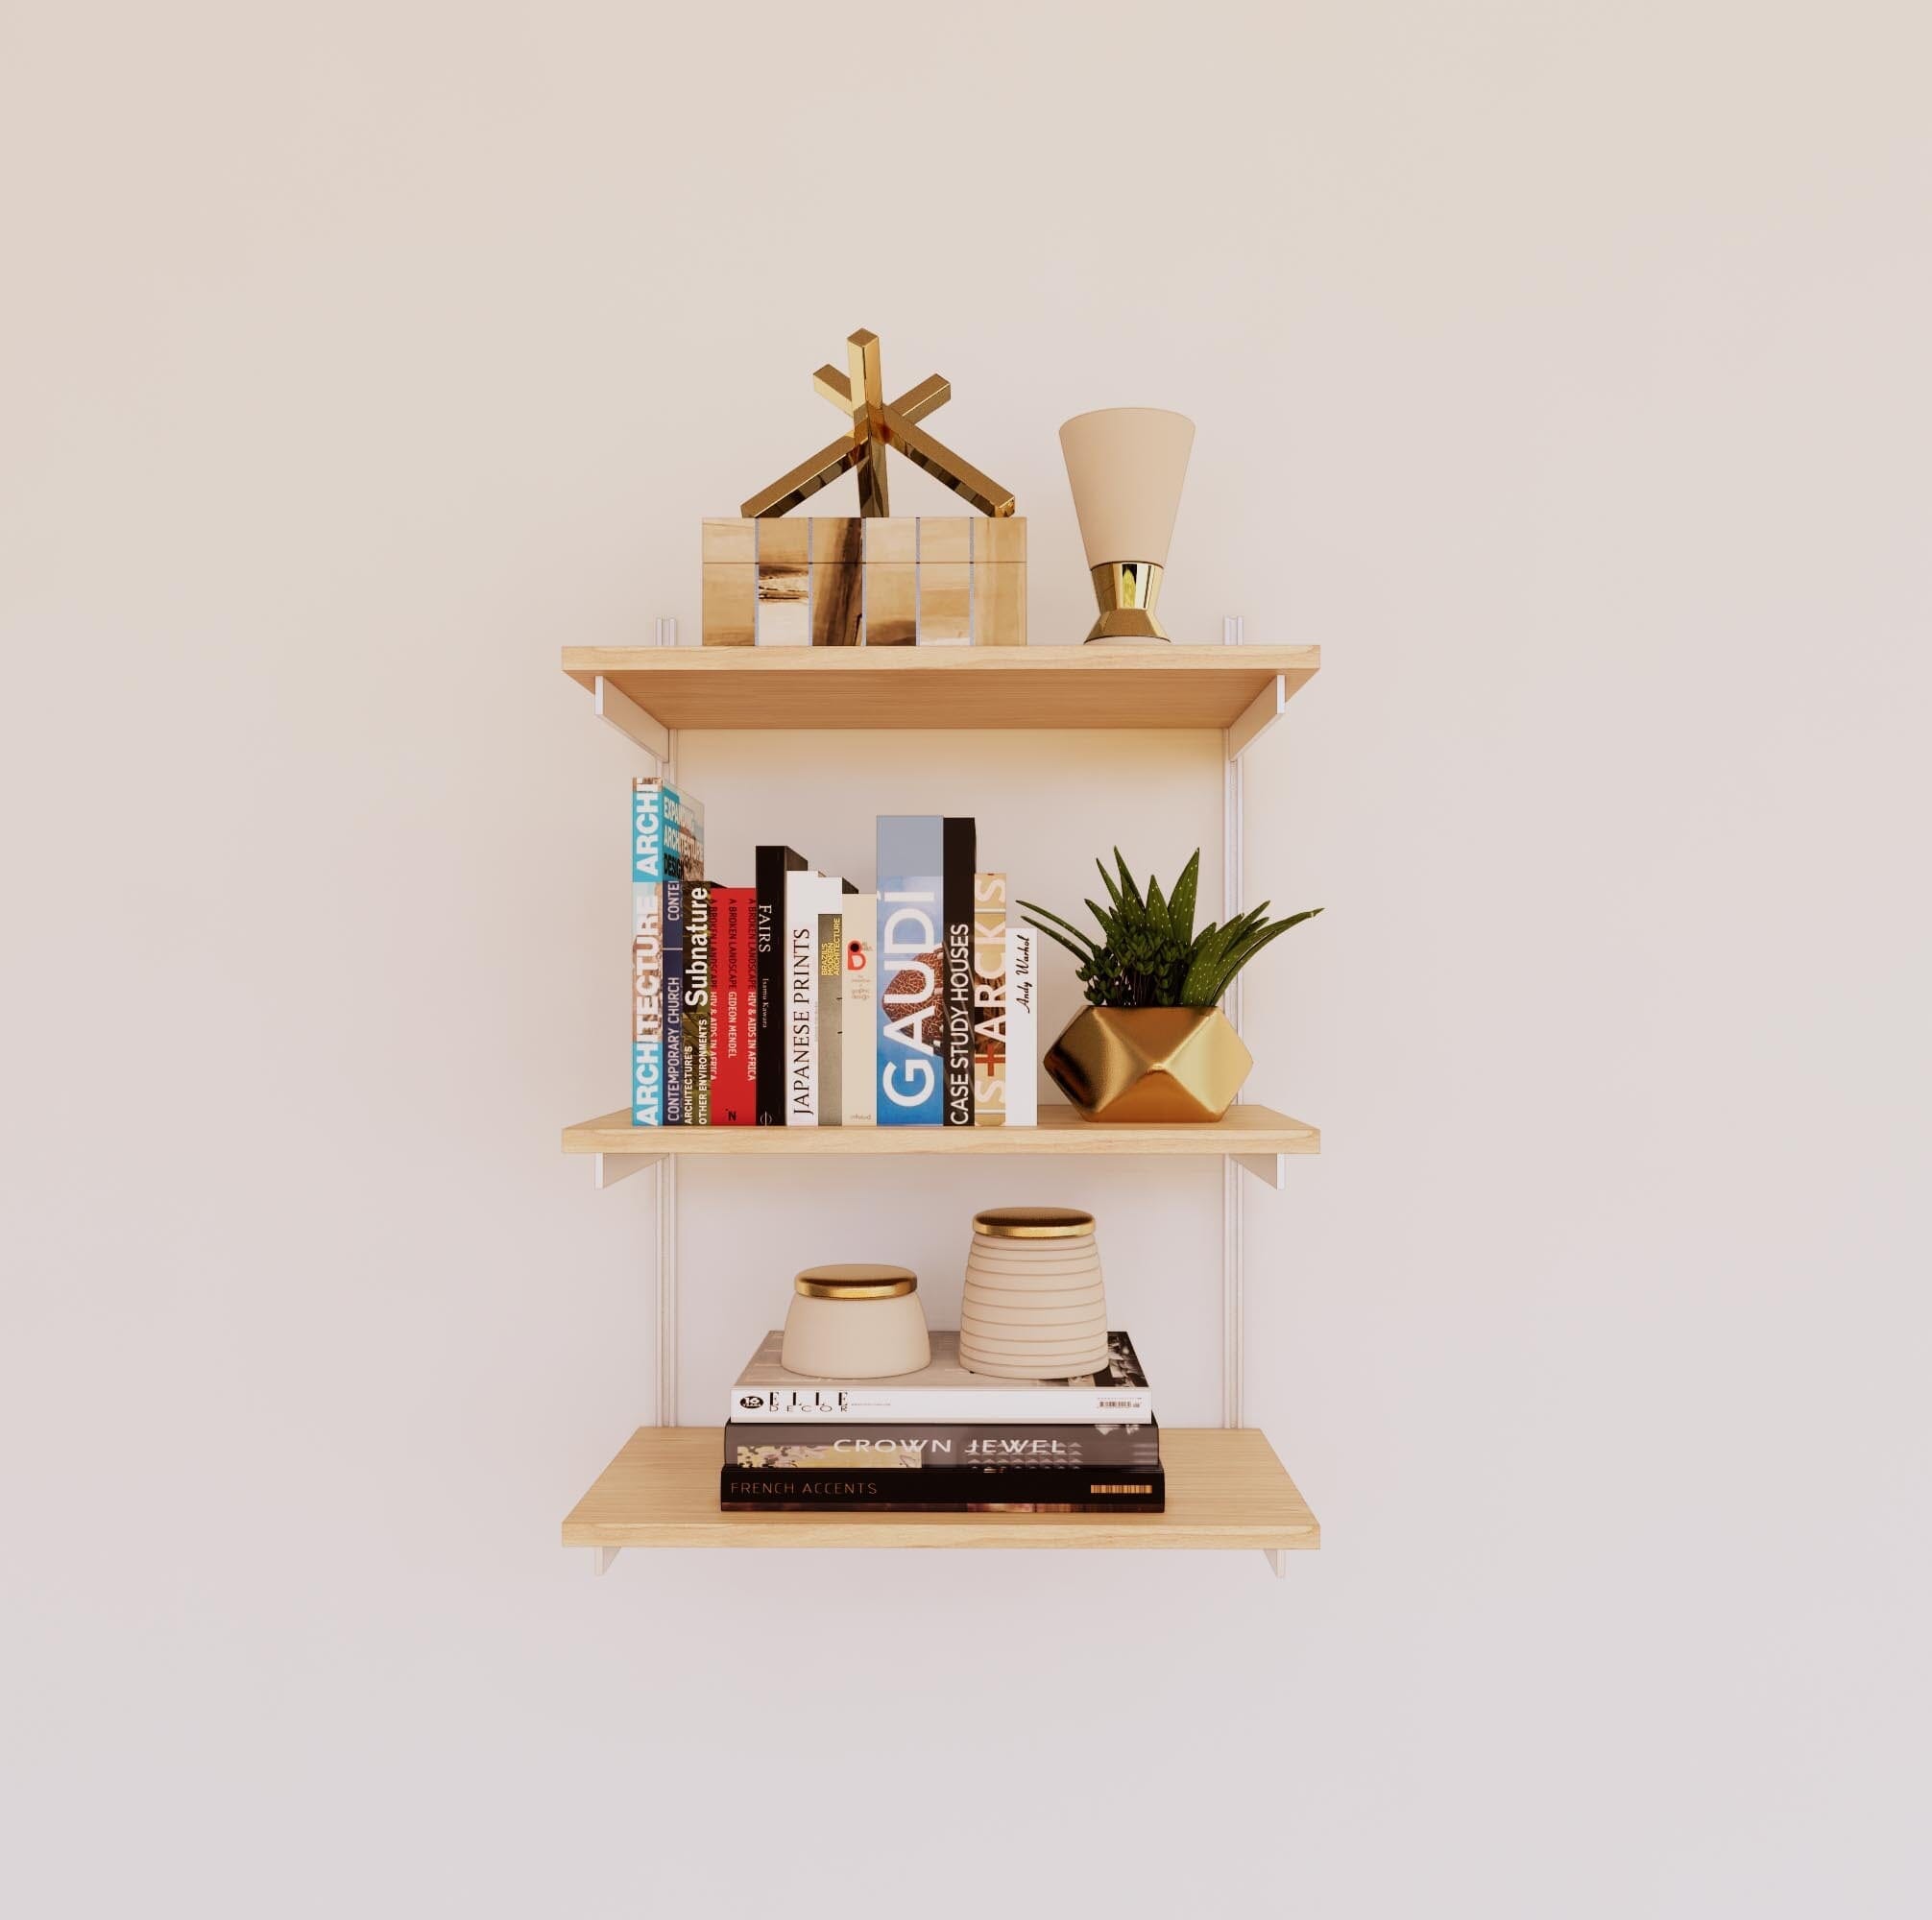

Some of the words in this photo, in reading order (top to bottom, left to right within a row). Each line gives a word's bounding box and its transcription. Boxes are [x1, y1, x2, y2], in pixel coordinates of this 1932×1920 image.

[728, 906, 737, 939] BROKEN
[759, 904, 772, 952] FAIRS
[685, 886, 709, 1007] Subnature
[793, 928, 810, 1004] PRINTS
[950, 924, 969, 1000] HOUSES
[1016, 934, 1030, 974] Warhol
[637, 889, 660, 1126] ARCHITECTURE
[667, 976, 680, 1023] CHURCH
[728, 992, 737, 1023] GIDEON
[747, 992, 757, 1006] HIV
[1016, 981, 1033, 1014] Andy
[698, 1019, 708, 1094] ENVIRONMENTS
[728, 1025, 737, 1059] MENDEL
[747, 1039, 757, 1048] IN
[950, 1007, 969, 1068] STUDY
[667, 1028, 680, 1121] CONTEMPORARY
[747, 1051, 757, 1081] AFRICA
[793, 1011, 813, 1116] JAPANESE
[698, 1095, 708, 1125] OTHER
[950, 1073, 969, 1125] CASE
[833, 1439, 952, 1452] CROWN
[964, 1439, 1066, 1452] JEWEL
[730, 1482, 794, 1495] FRENCH
[802, 1482, 878, 1495] ACCENTS
